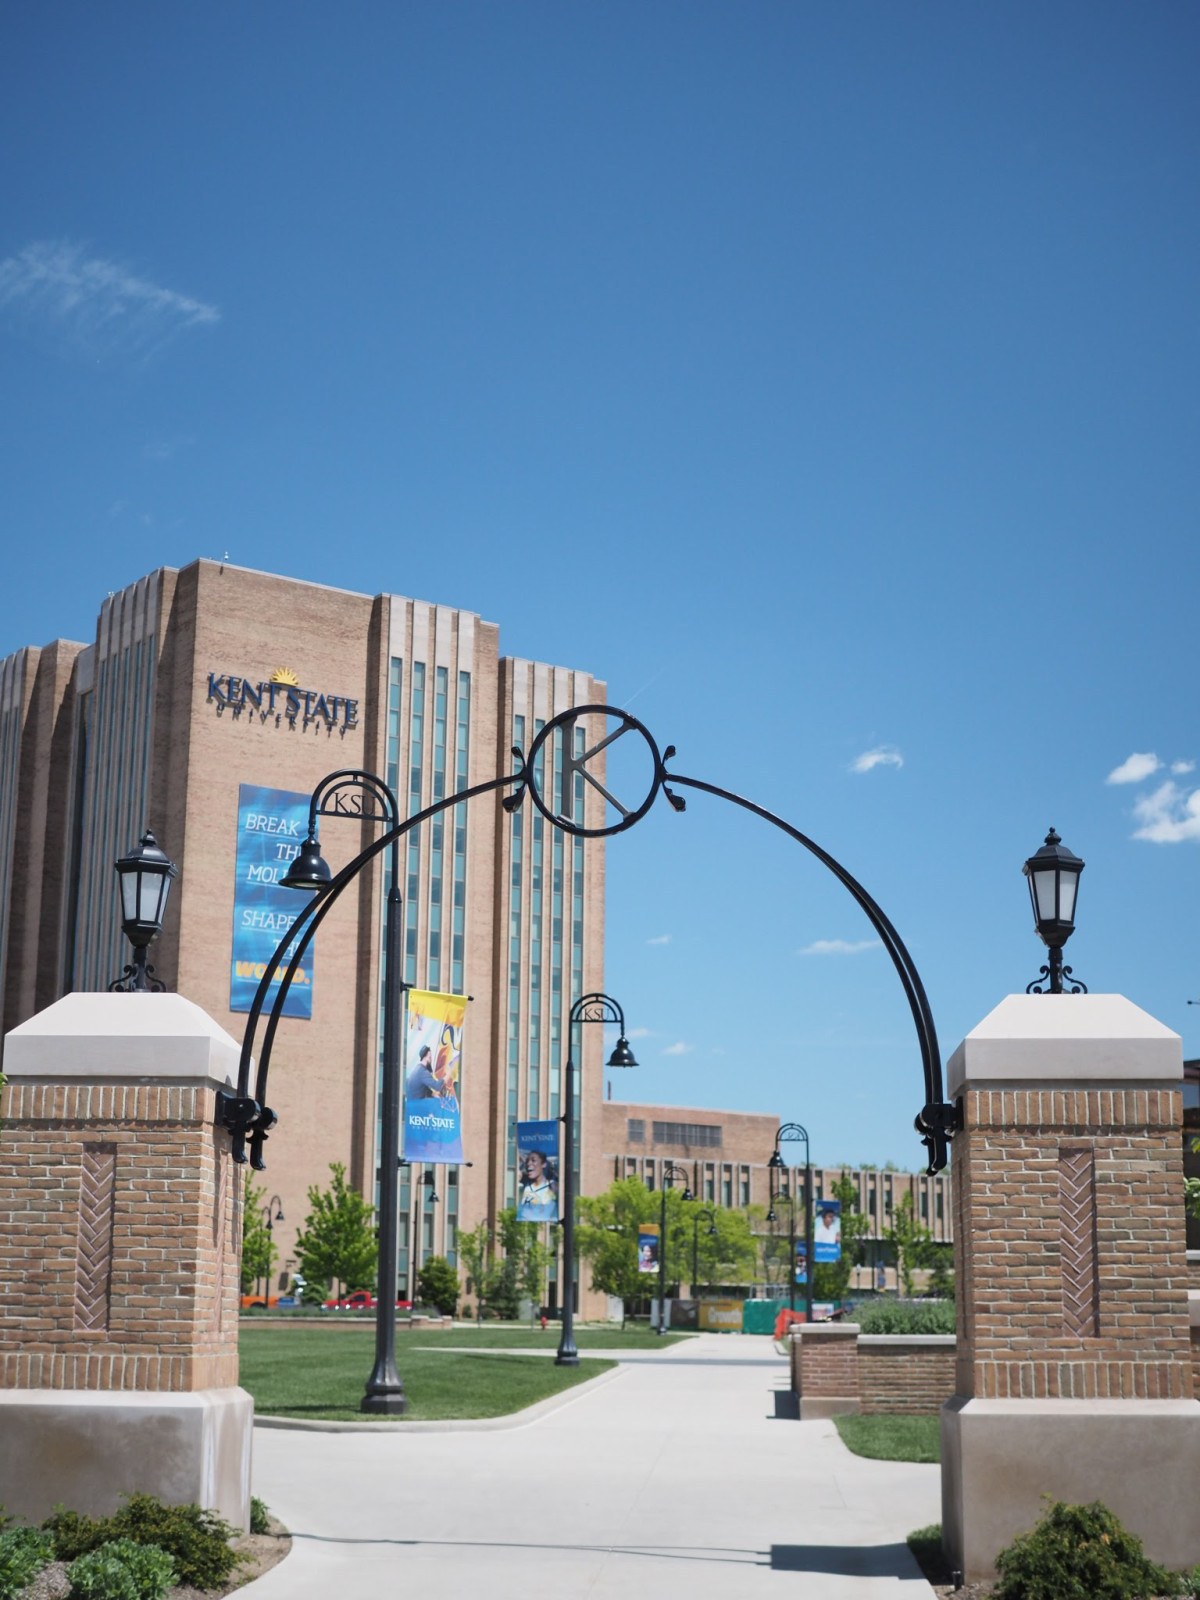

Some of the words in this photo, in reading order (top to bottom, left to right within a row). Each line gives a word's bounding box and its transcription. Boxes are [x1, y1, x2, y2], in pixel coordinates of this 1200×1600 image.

[207, 671, 281, 711] KENT
[286, 685, 359, 725] STATE
[216, 702, 348, 737] UNIVERSITY
[334, 792, 377, 816] KSU
[245, 812, 301, 836] BREAK
[276, 842, 302, 860] TH
[273, 939, 300, 957] TH
[409, 1115, 431, 1127] KENT
[431, 1117, 455, 1129] STATE
